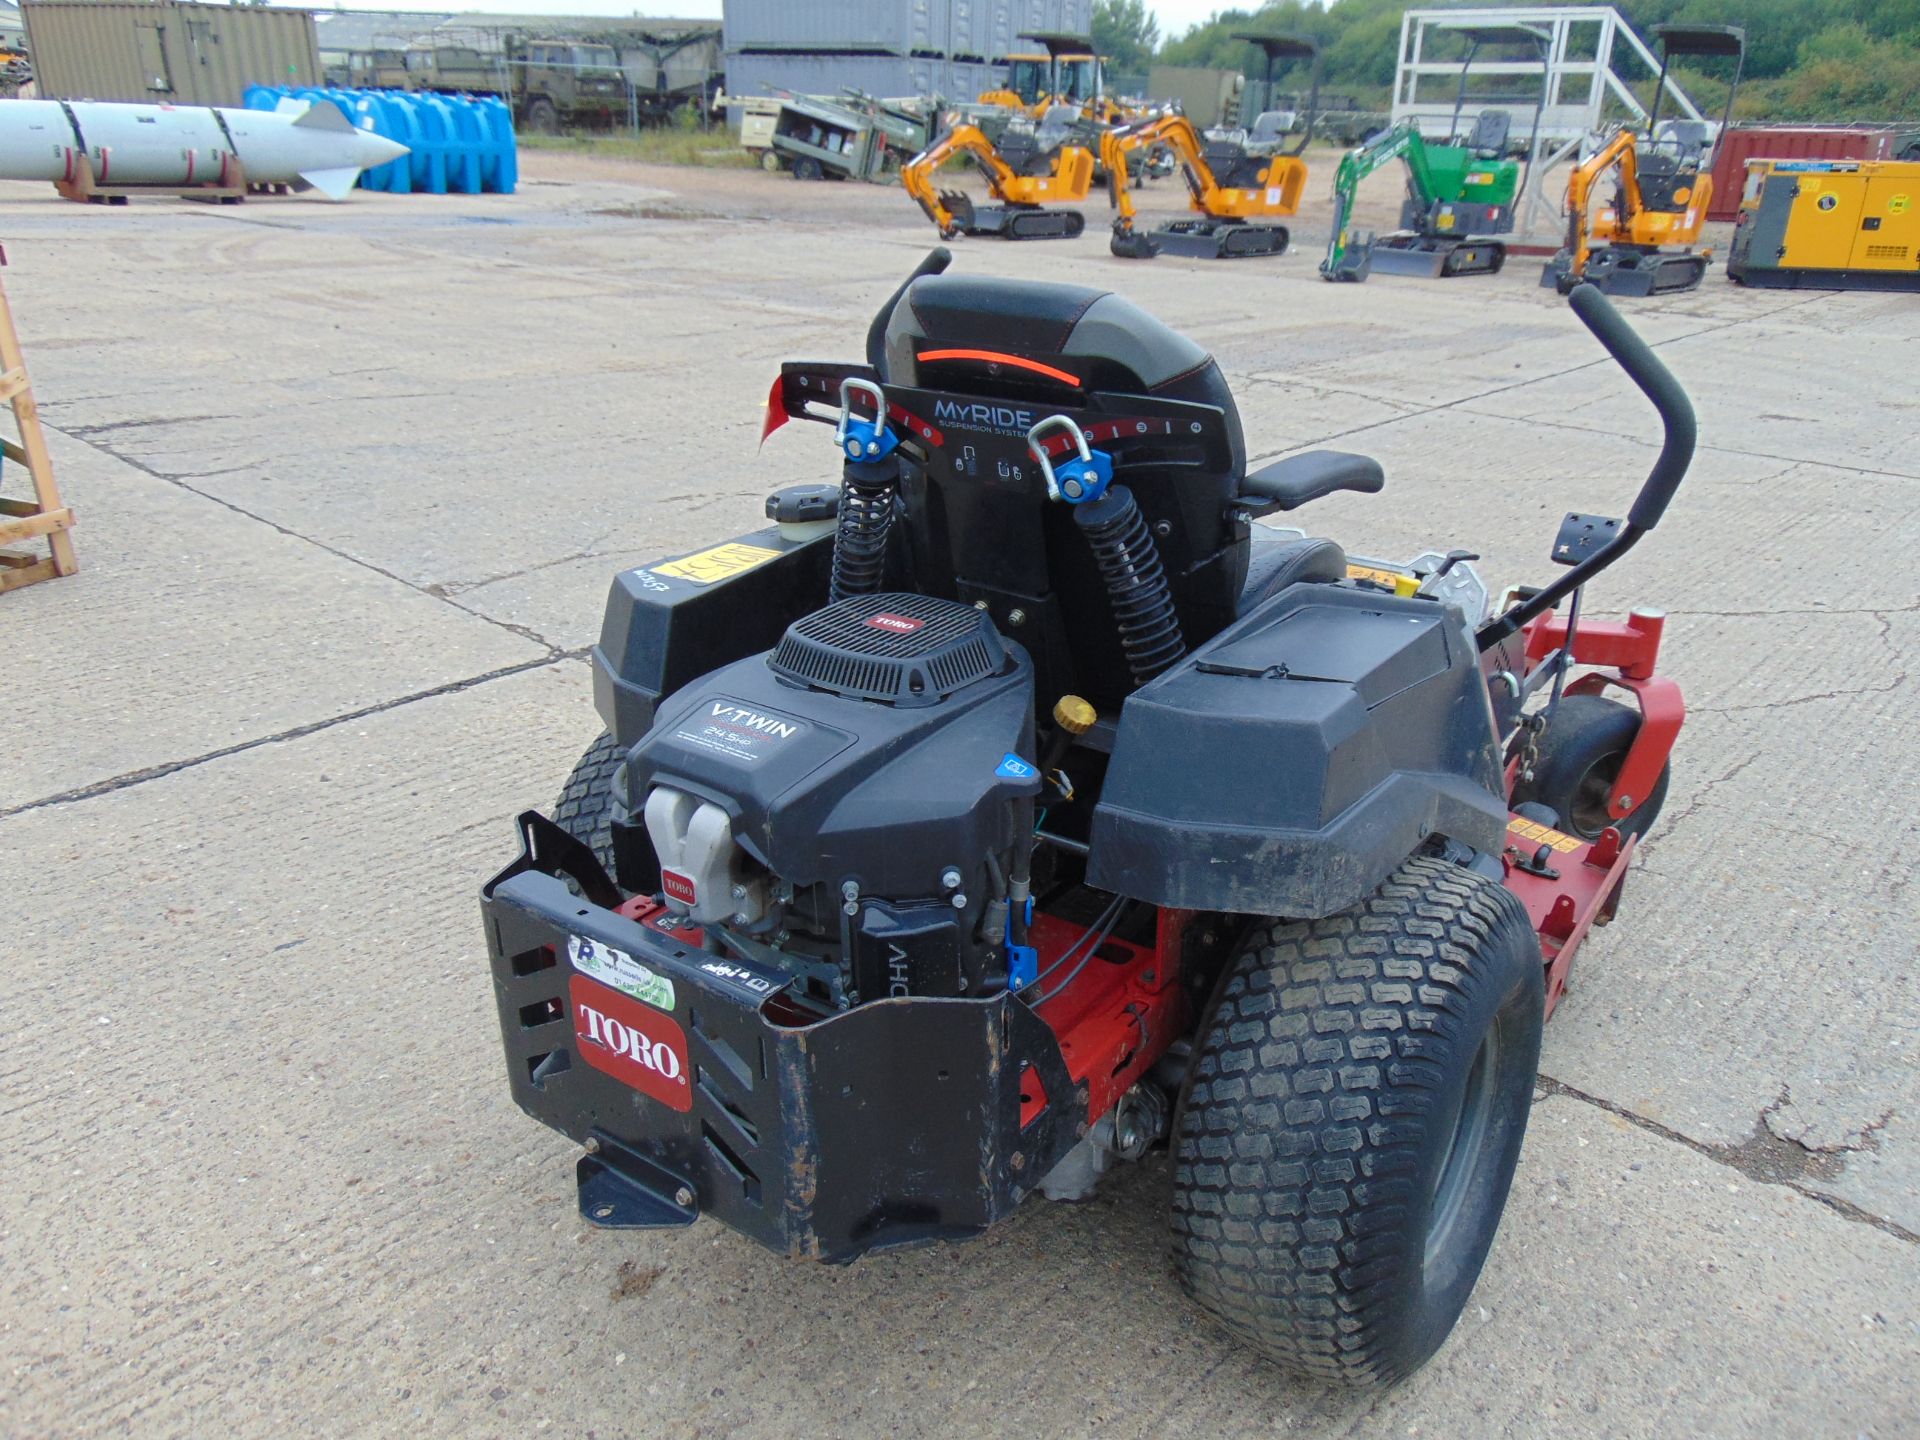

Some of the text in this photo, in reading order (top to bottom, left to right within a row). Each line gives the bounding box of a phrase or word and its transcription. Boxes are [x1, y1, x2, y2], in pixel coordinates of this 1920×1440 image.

[939, 420, 992, 433] SUSPENSION
[874, 617, 914, 629] TORO
[665, 879, 693, 897] TORO
[579, 1003, 680, 1079] TORO
